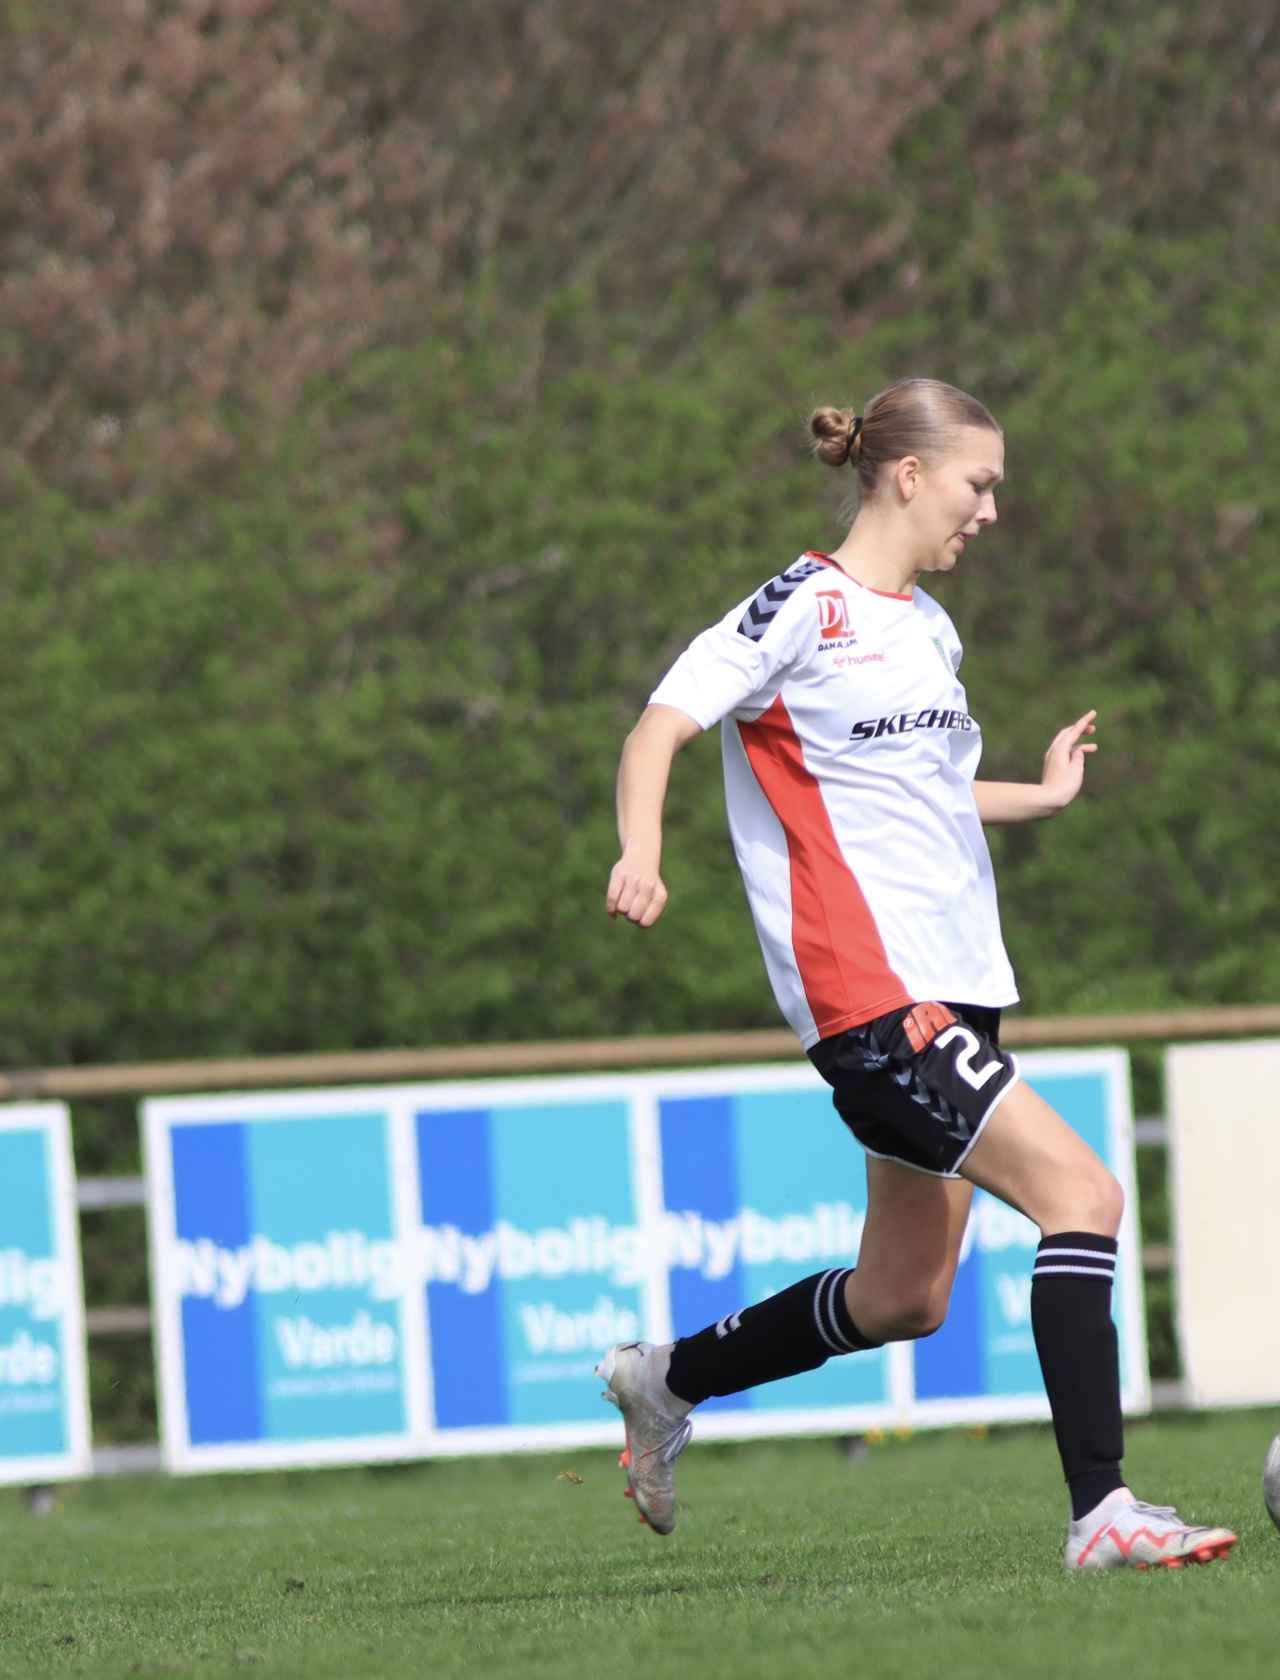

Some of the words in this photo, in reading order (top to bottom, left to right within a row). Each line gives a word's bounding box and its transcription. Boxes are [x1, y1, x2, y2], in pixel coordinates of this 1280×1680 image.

[934, 1026, 1004, 1091] 2
[168, 1229, 402, 1309] Nybolig
[412, 1216, 642, 1294] Nybolig
[656, 1203, 868, 1281] Nyboli
[276, 1310, 395, 1369] Varde
[522, 1299, 639, 1355] Varde
